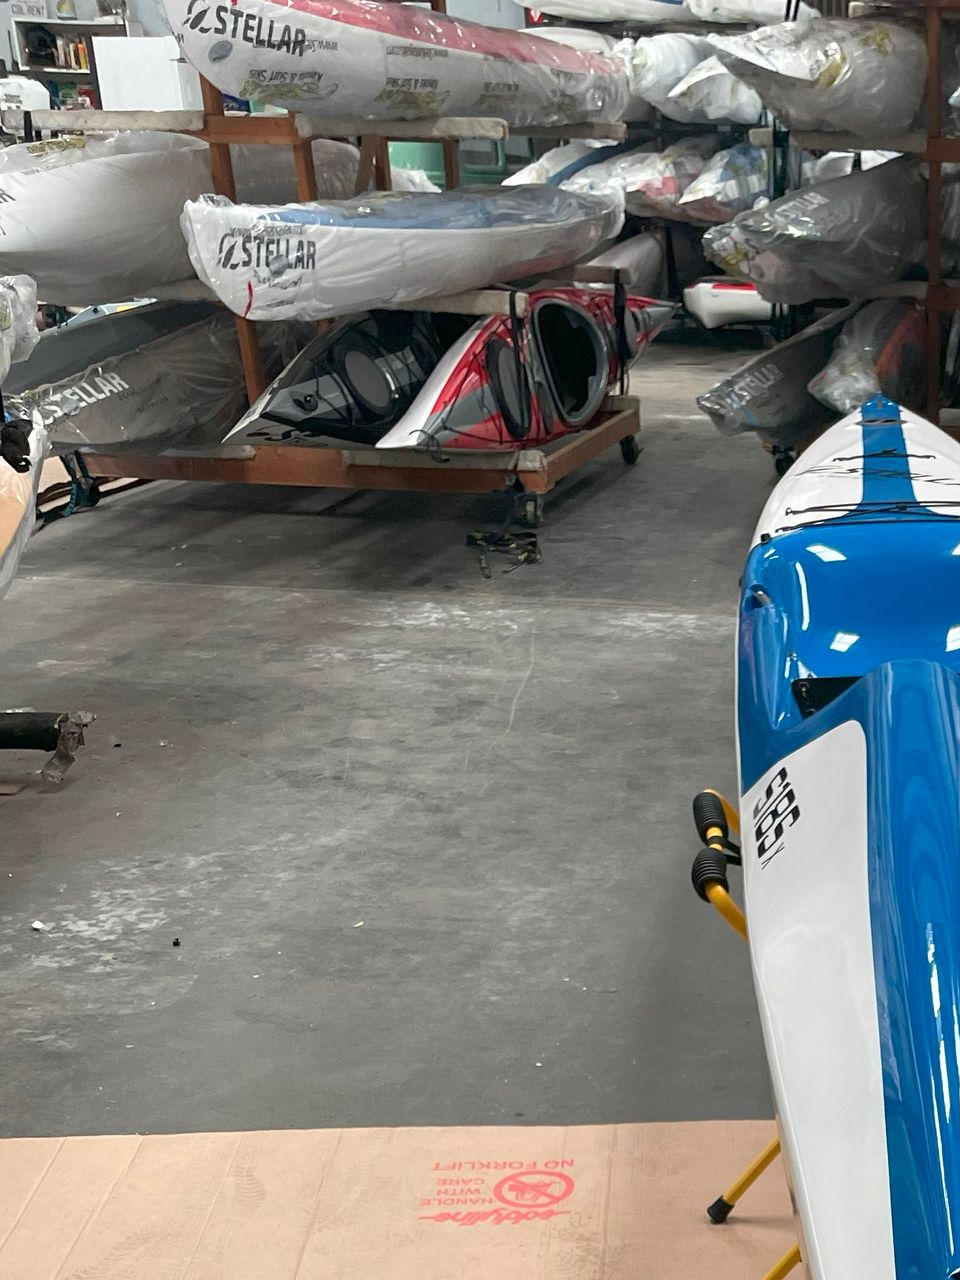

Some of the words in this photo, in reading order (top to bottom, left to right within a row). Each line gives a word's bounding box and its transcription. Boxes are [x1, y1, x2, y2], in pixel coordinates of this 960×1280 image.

[214, 5, 306, 57] STELLAR
[430, 1160, 539, 1172] FORKLIFT
[544, 1158, 575, 1169] NO
[435, 1177, 485, 1187] CARE
[436, 1187, 481, 1196] WITH
[419, 1197, 494, 1207] HANDLE
